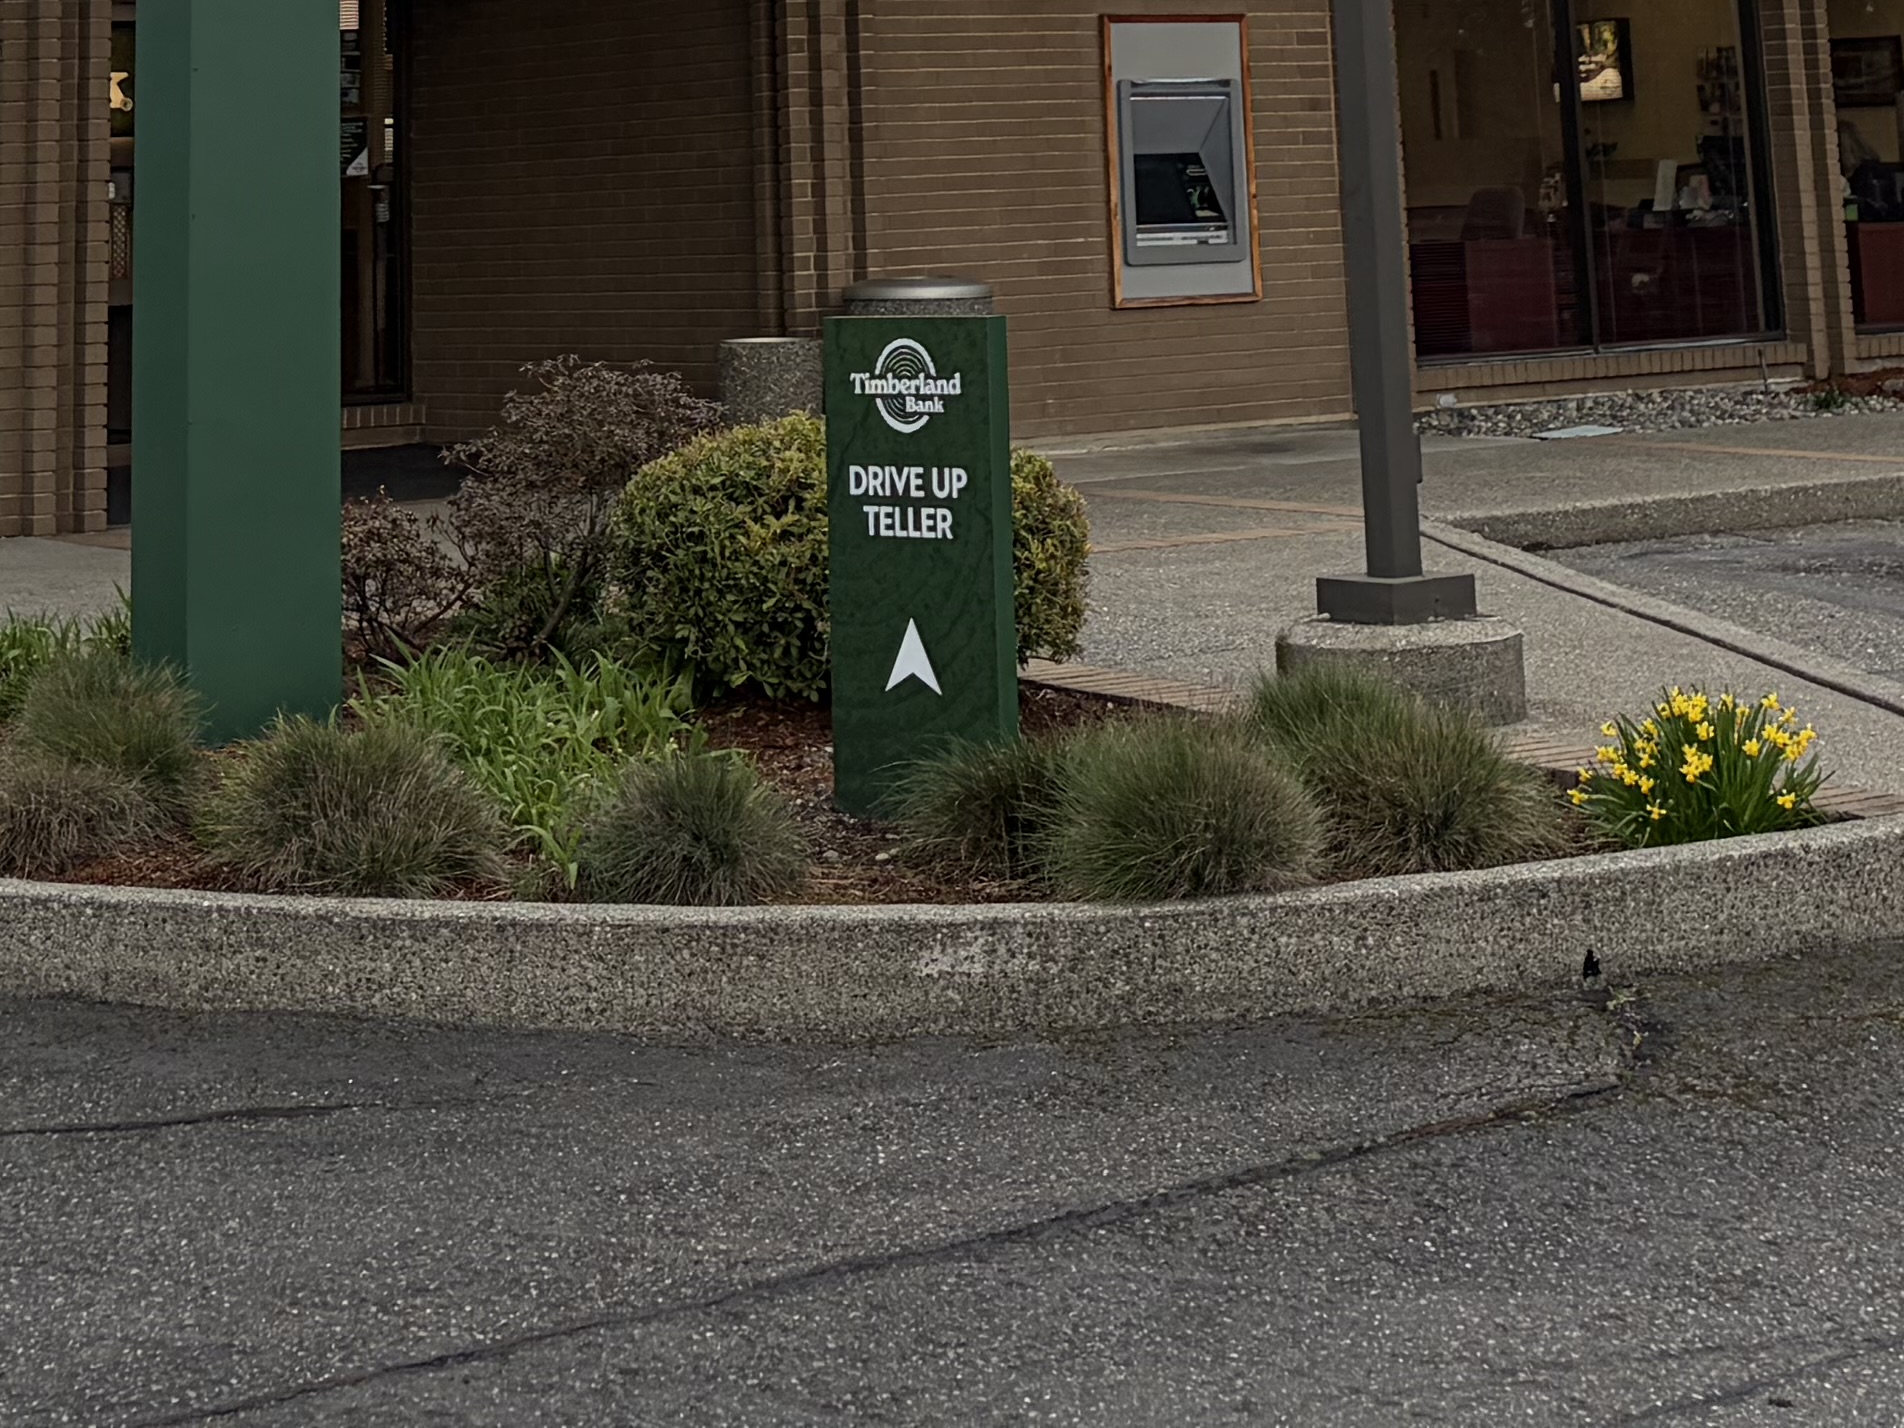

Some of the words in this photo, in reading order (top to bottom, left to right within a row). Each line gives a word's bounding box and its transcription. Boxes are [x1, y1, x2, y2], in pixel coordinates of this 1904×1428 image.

[850, 372, 961, 395] Timberland
[905, 396, 945, 414] Bank
[848, 465, 925, 498] DRIVE
[932, 467, 968, 500] UP
[862, 504, 954, 540] TELLER
